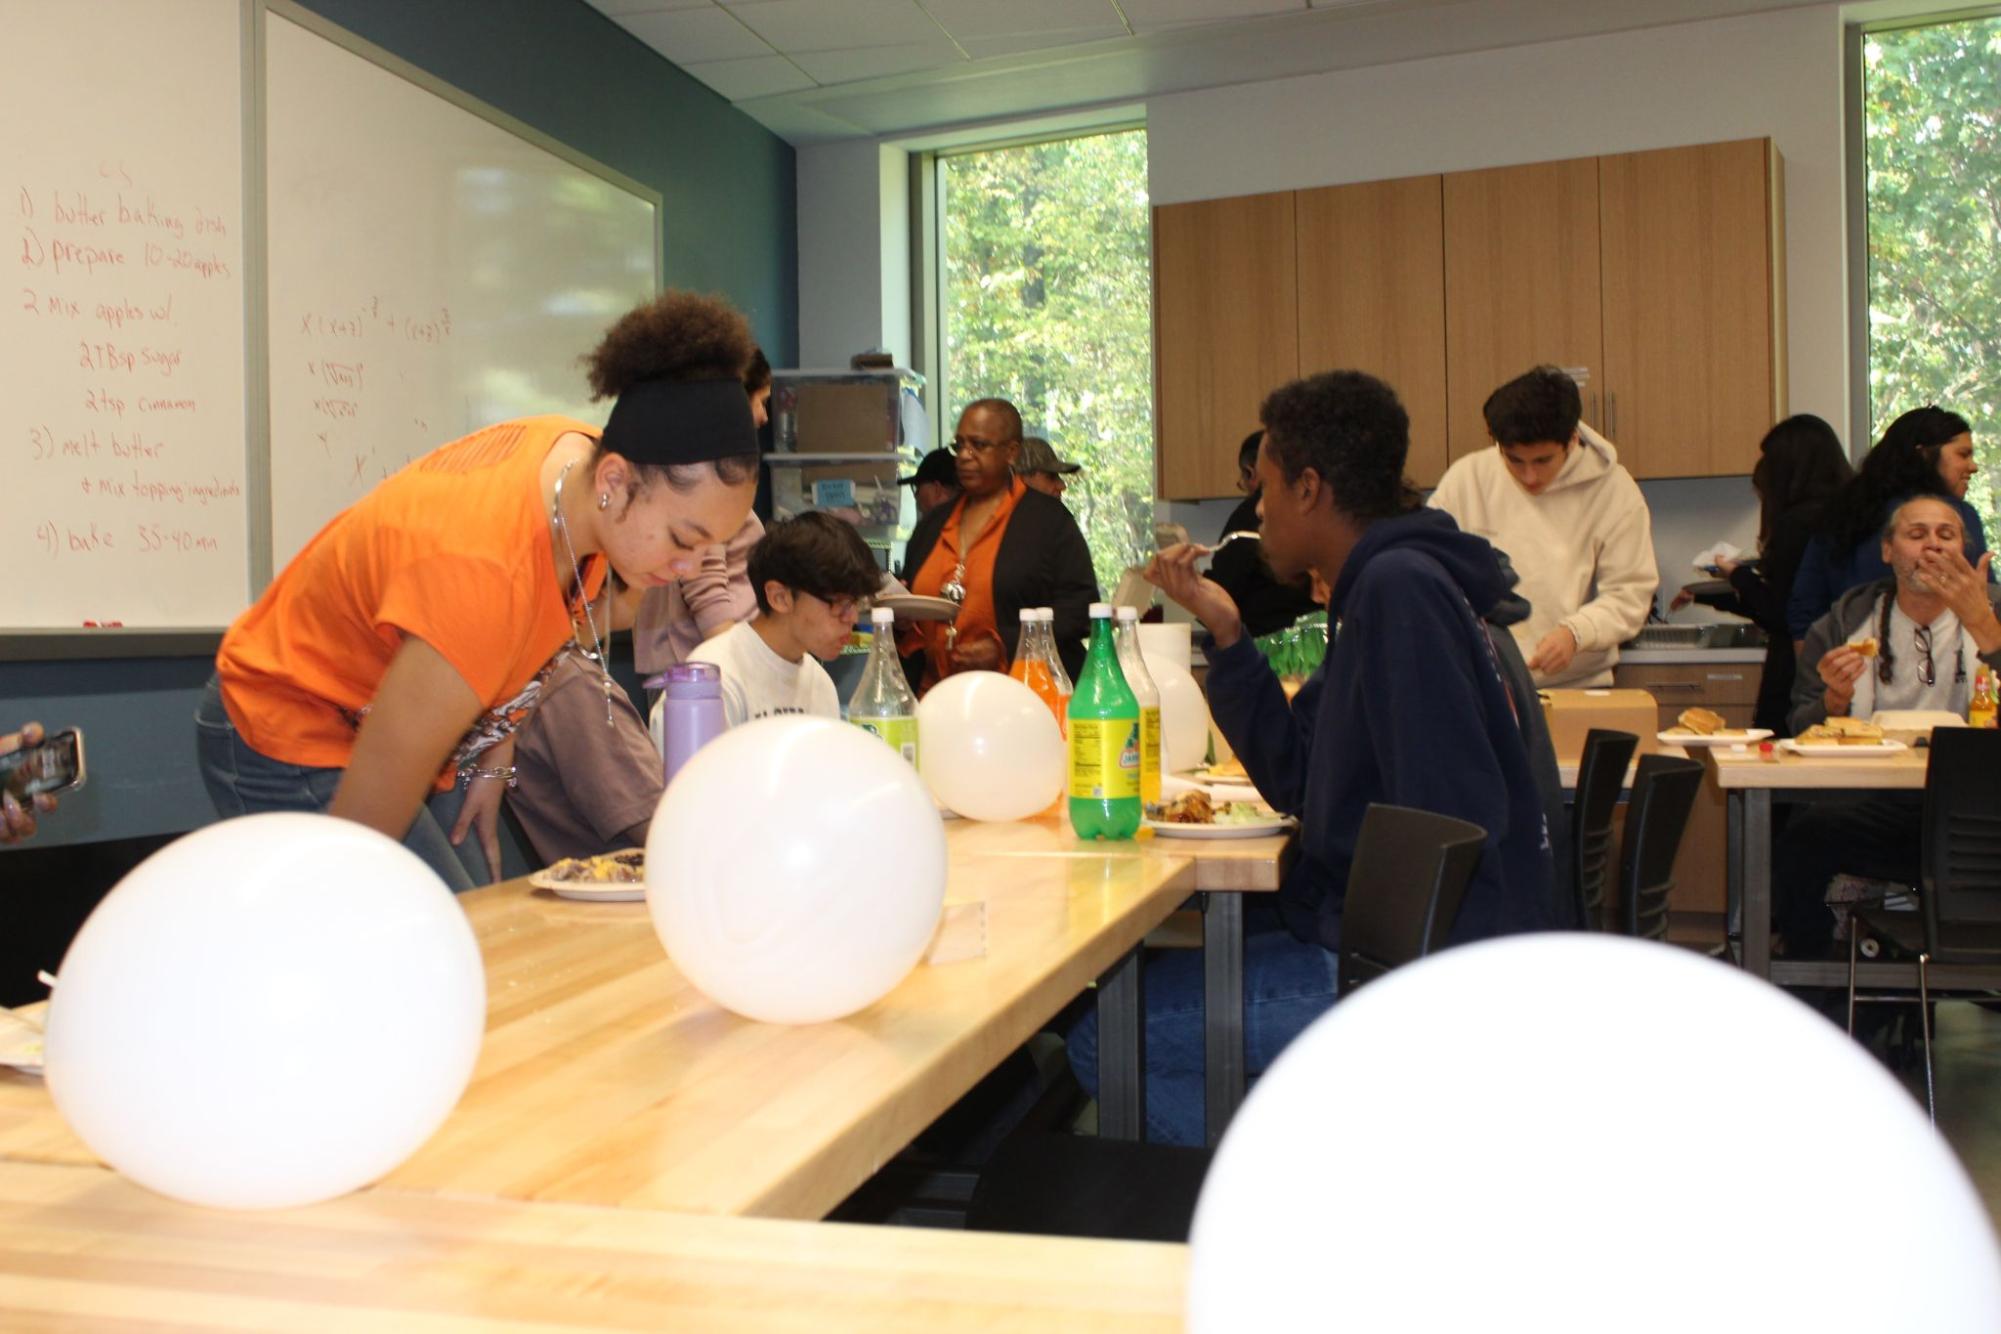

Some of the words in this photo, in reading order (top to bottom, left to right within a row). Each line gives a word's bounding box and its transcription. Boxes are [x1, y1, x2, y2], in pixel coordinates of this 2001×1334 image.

[54, 191, 105, 226] butter
[118, 193, 184, 239] baking
[53, 239, 125, 275] prepare
[96, 298, 144, 329] apples
[112, 432, 164, 459] butter
[133, 469, 185, 504] topping
[68, 522, 114, 551] bake
